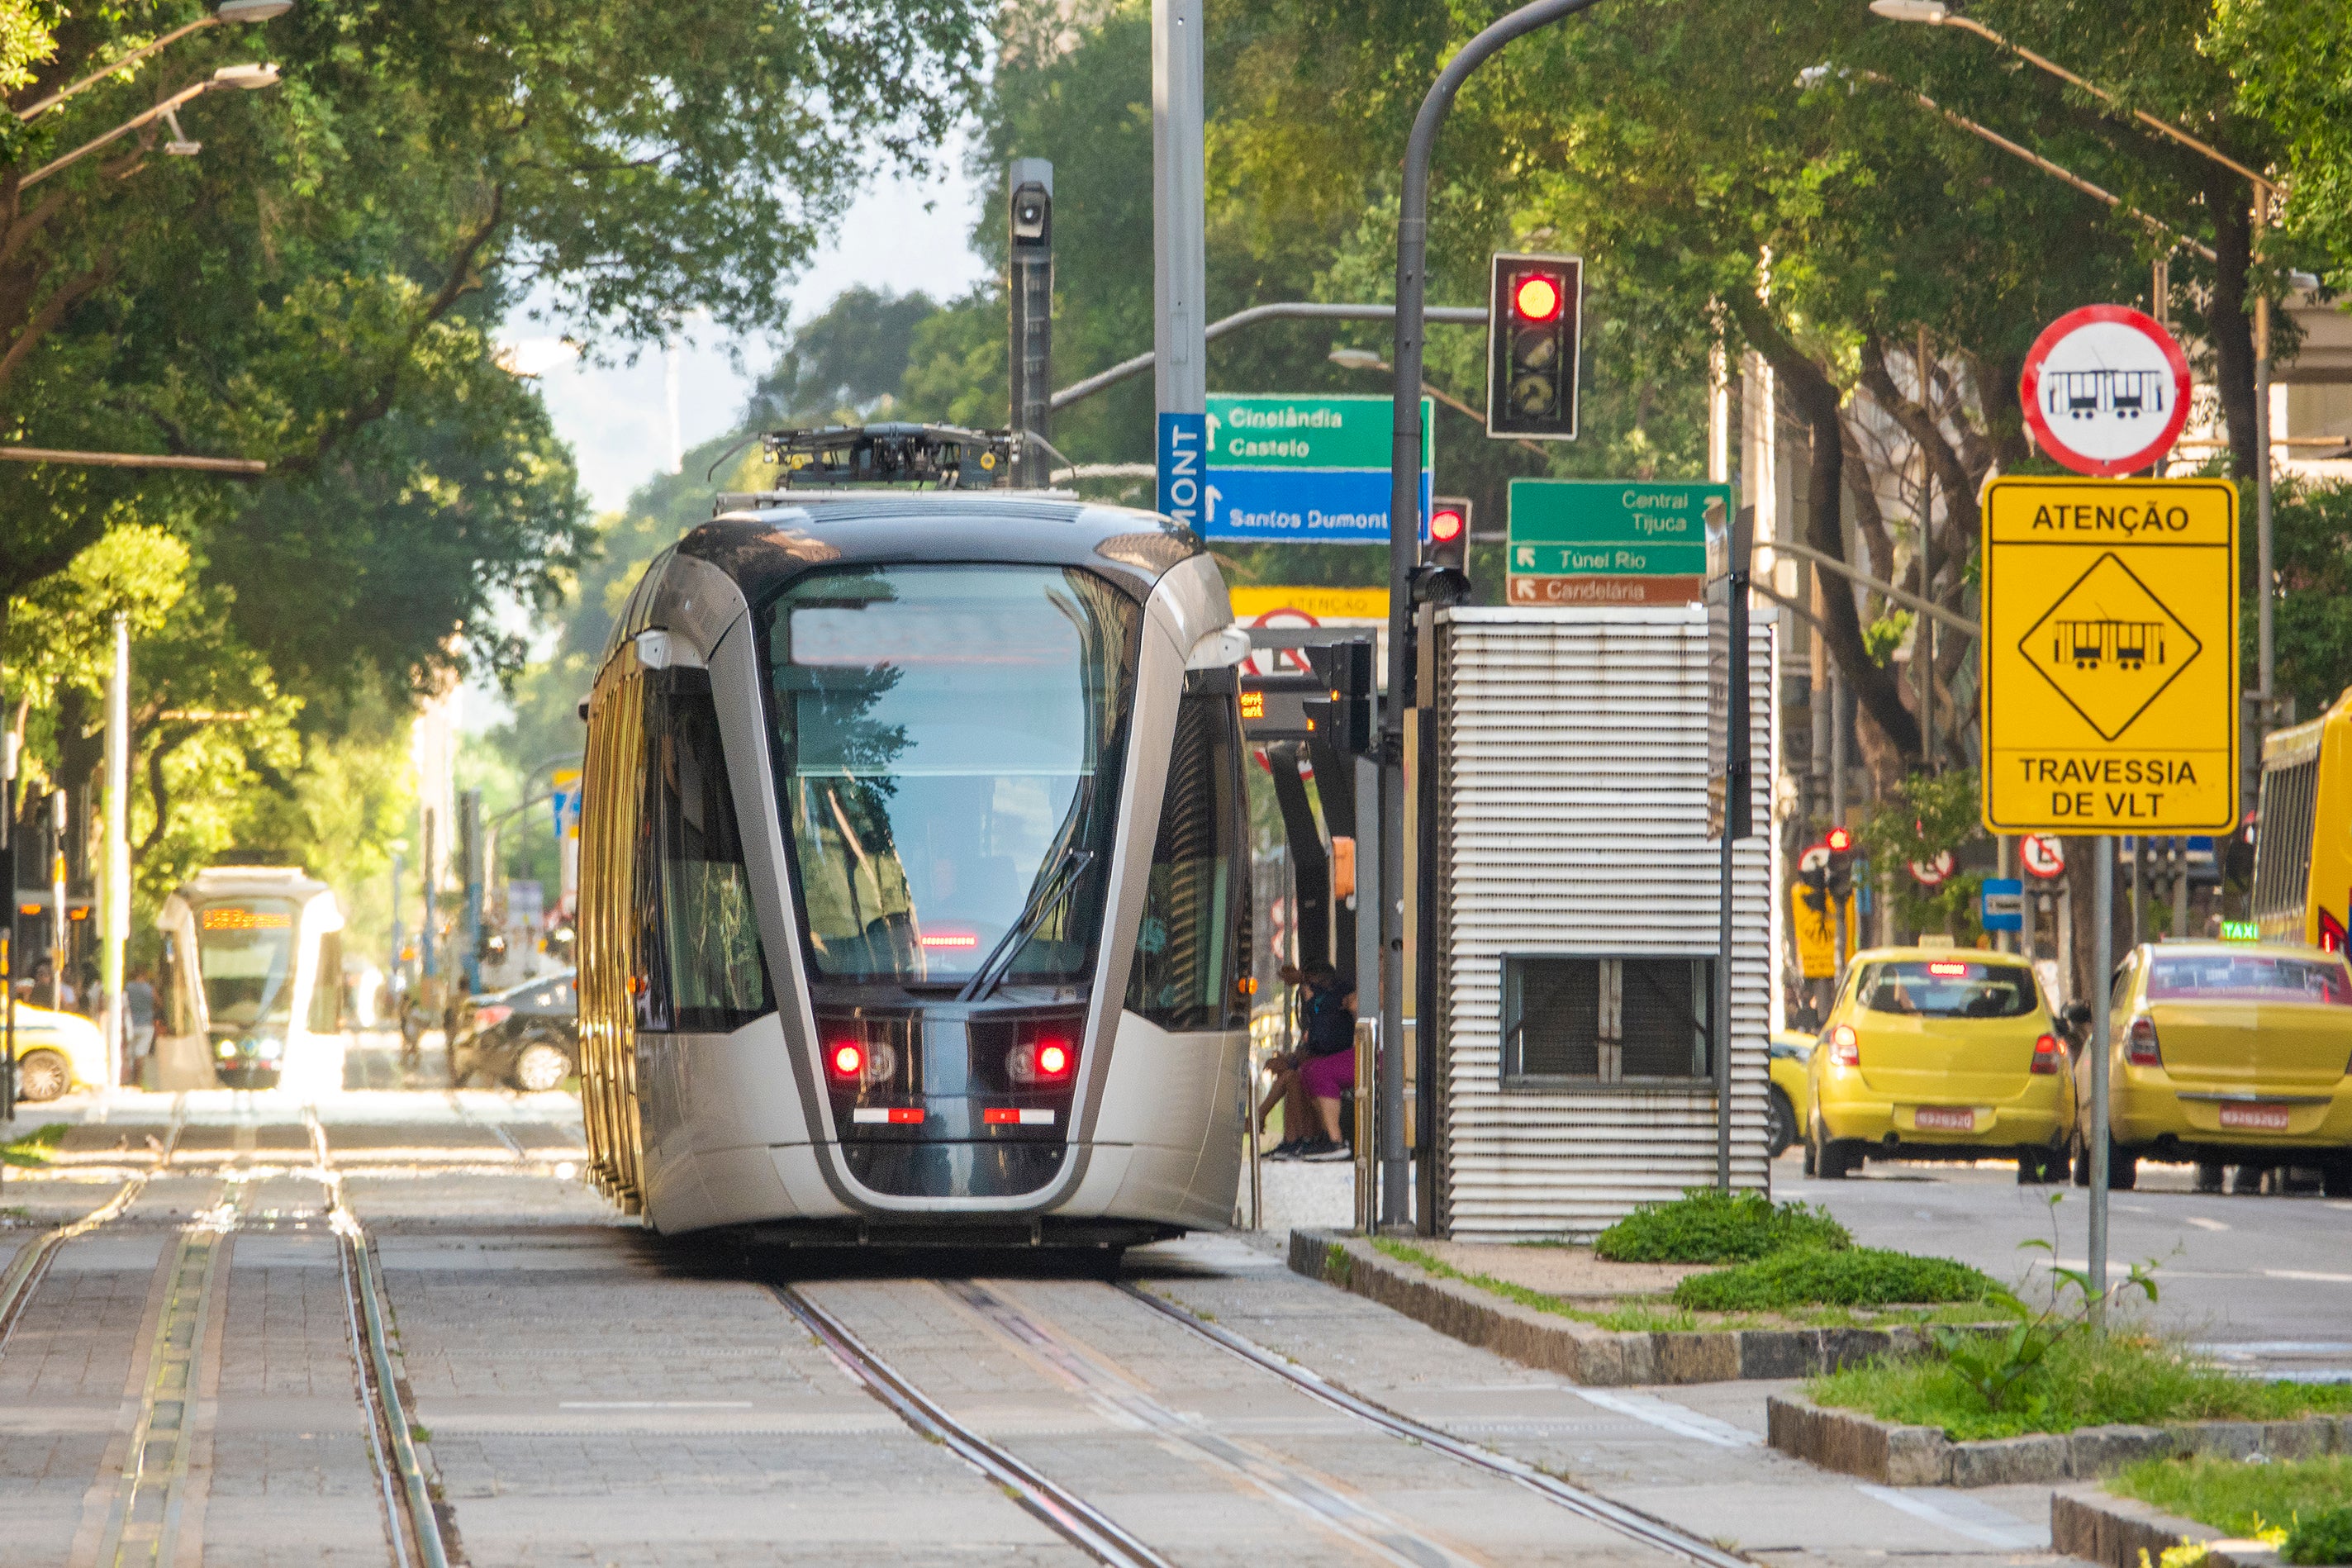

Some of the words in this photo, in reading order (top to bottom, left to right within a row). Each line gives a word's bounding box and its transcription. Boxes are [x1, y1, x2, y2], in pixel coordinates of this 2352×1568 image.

[1228, 406, 1342, 429] Cinelândia
[1228, 438, 1309, 459] Castelo
[1622, 489, 1689, 510] Central
[1229, 509, 1301, 530] Santos
[1308, 509, 1388, 530] Dumont
[1632, 513, 1687, 535] Tijuca
[2031, 500, 2189, 537] ATENÇÃO
[1559, 549, 1609, 568] Túnel
[1615, 551, 1646, 570] Rio
[1547, 580, 1645, 601] Candelária
[2019, 758, 2197, 785] TRAVESSIA
[2051, 792, 2094, 816] DE
[2106, 793, 2164, 817] VLT
[2221, 920, 2259, 939] TAXI
